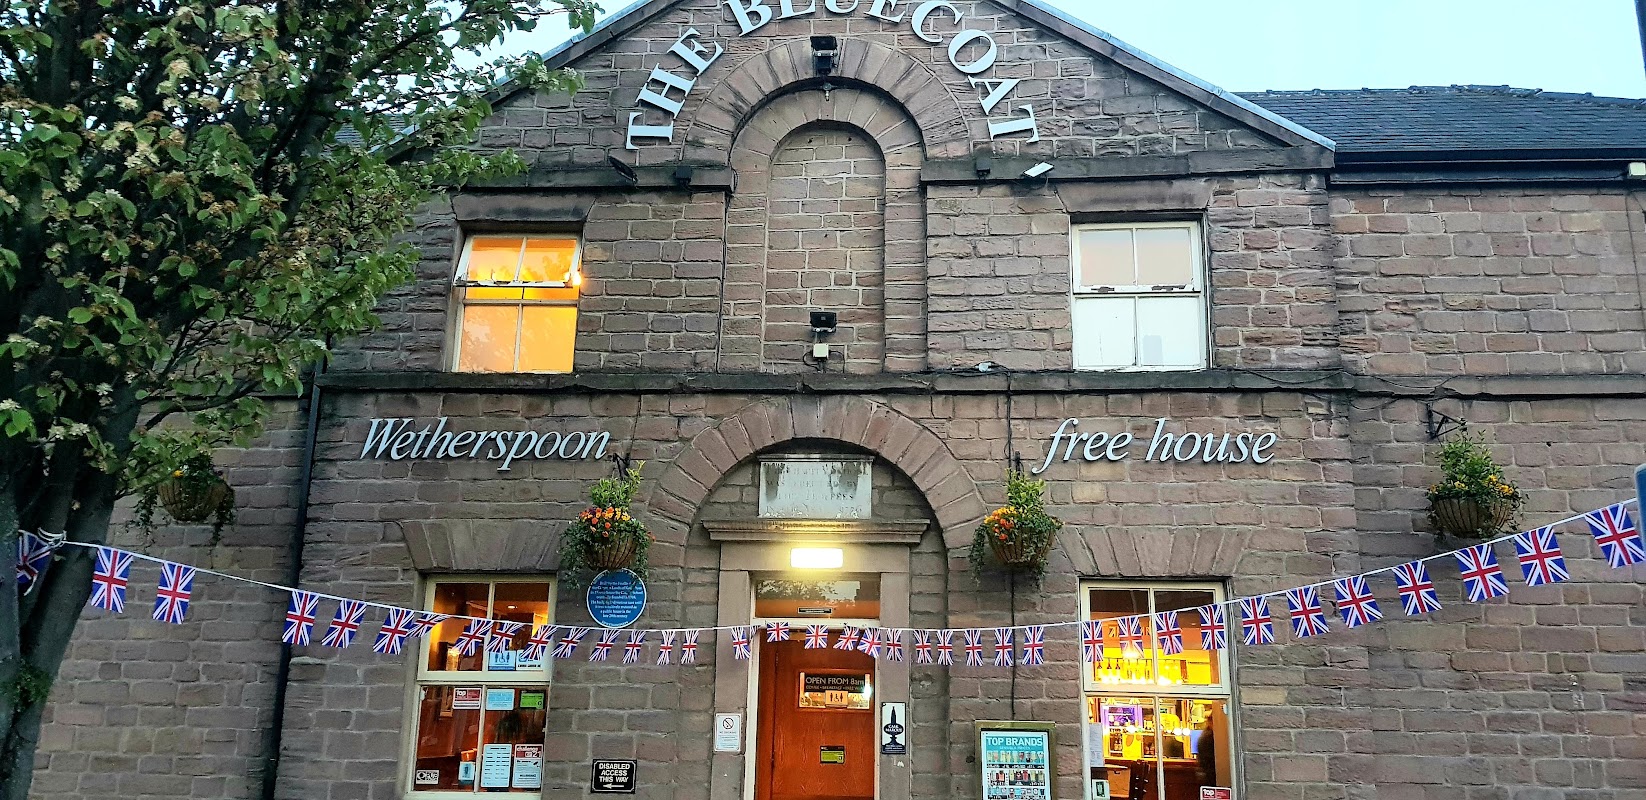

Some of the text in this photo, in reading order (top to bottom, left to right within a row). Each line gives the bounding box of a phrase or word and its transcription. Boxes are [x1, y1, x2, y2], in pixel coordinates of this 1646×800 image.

[625, 27, 723, 150] THE
[360, 417, 610, 471] Wetherspoon
[1031, 417, 1277, 474] free house
[805, 676, 828, 685] OPEN
[828, 677, 849, 685] FROM
[986, 737, 1043, 747] TOP BRANDS
[598, 762, 631, 770] DISABLED
[600, 769, 628, 777] ACCESS
